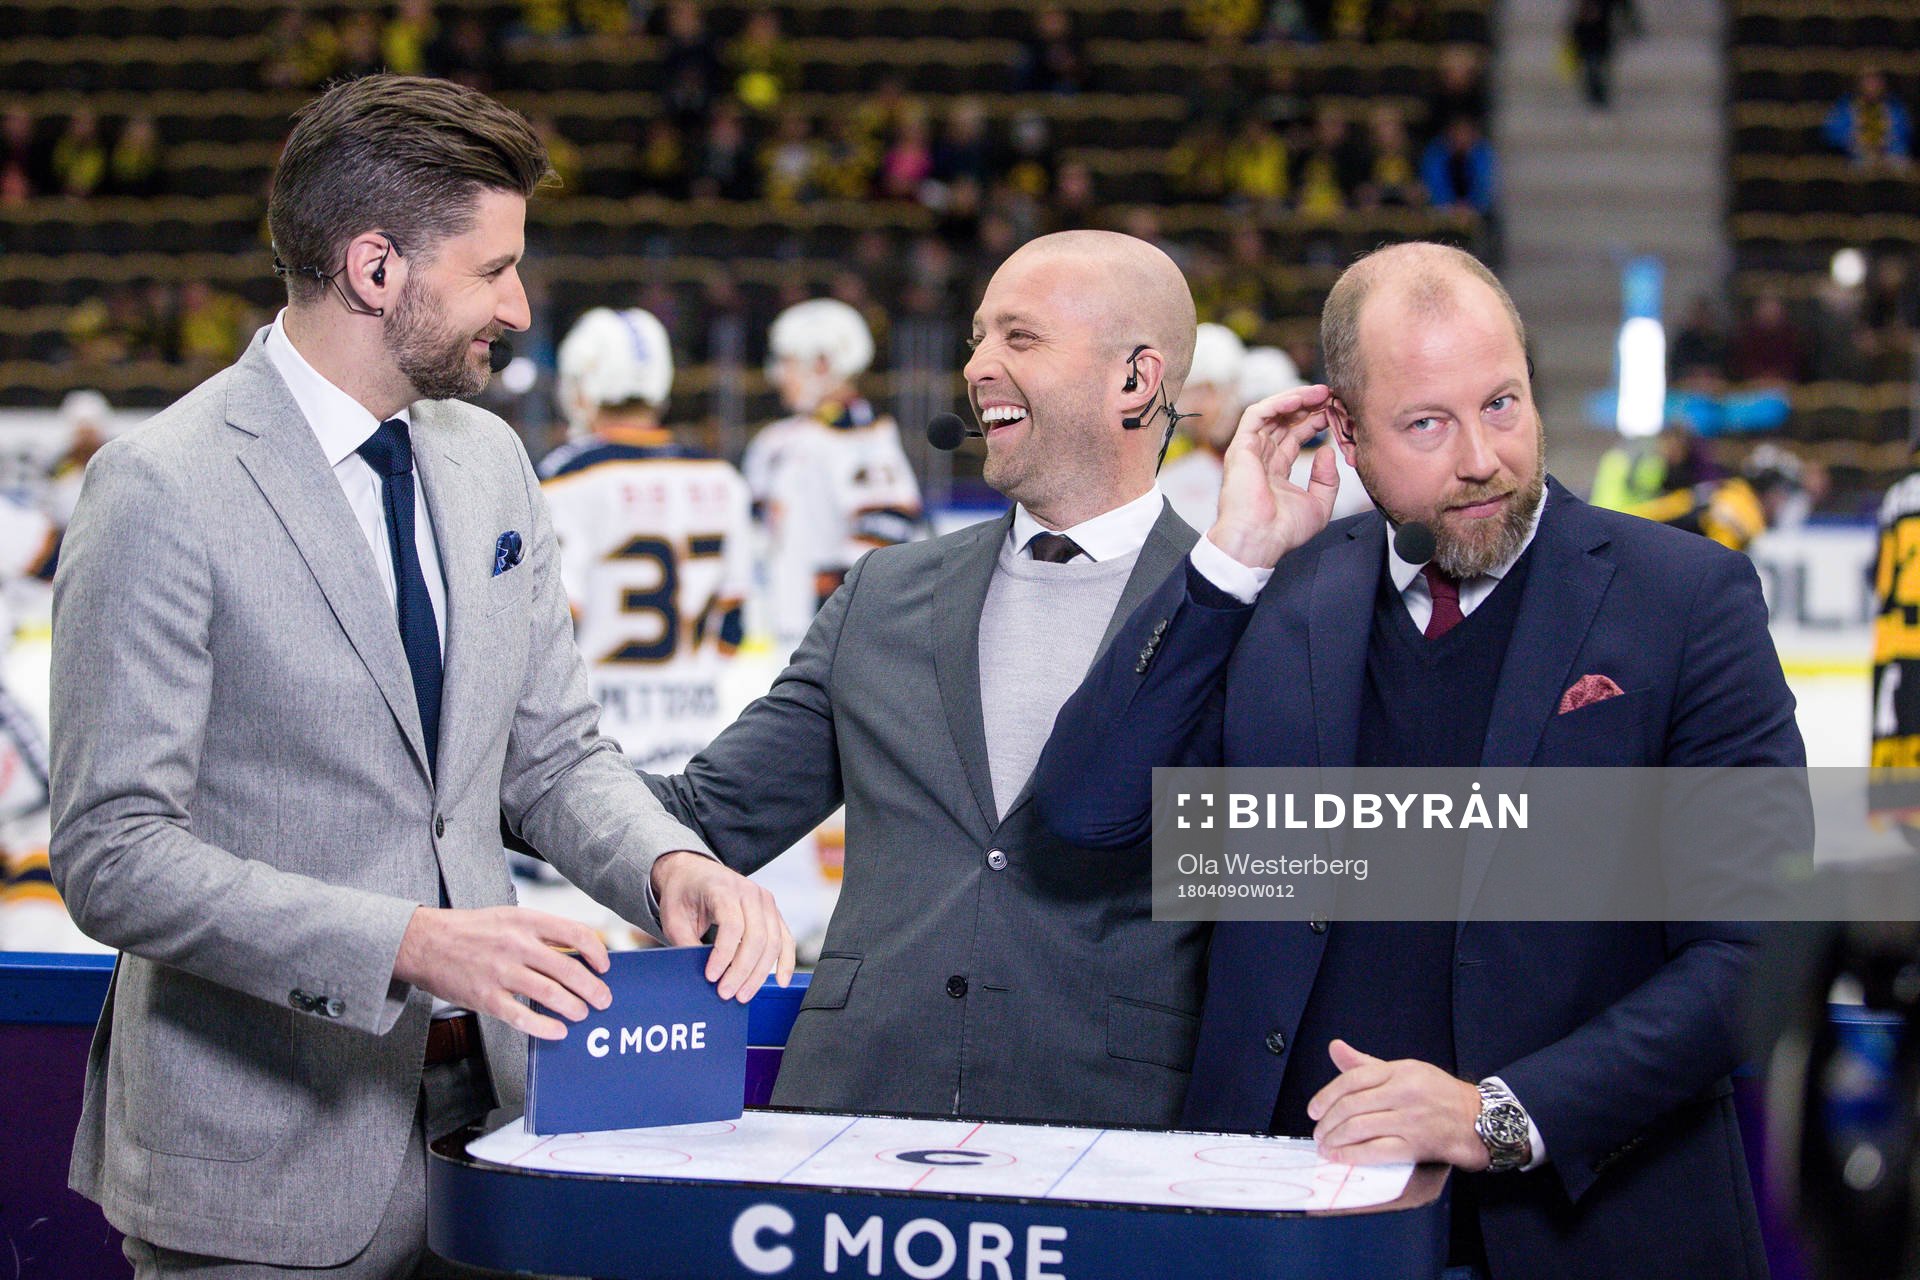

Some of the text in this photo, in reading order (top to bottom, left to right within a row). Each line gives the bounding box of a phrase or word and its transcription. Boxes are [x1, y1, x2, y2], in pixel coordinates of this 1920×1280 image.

[600, 533, 727, 664] 37
[586, 1022, 707, 1058] C MORE
[731, 1204, 1068, 1280] C MORE
